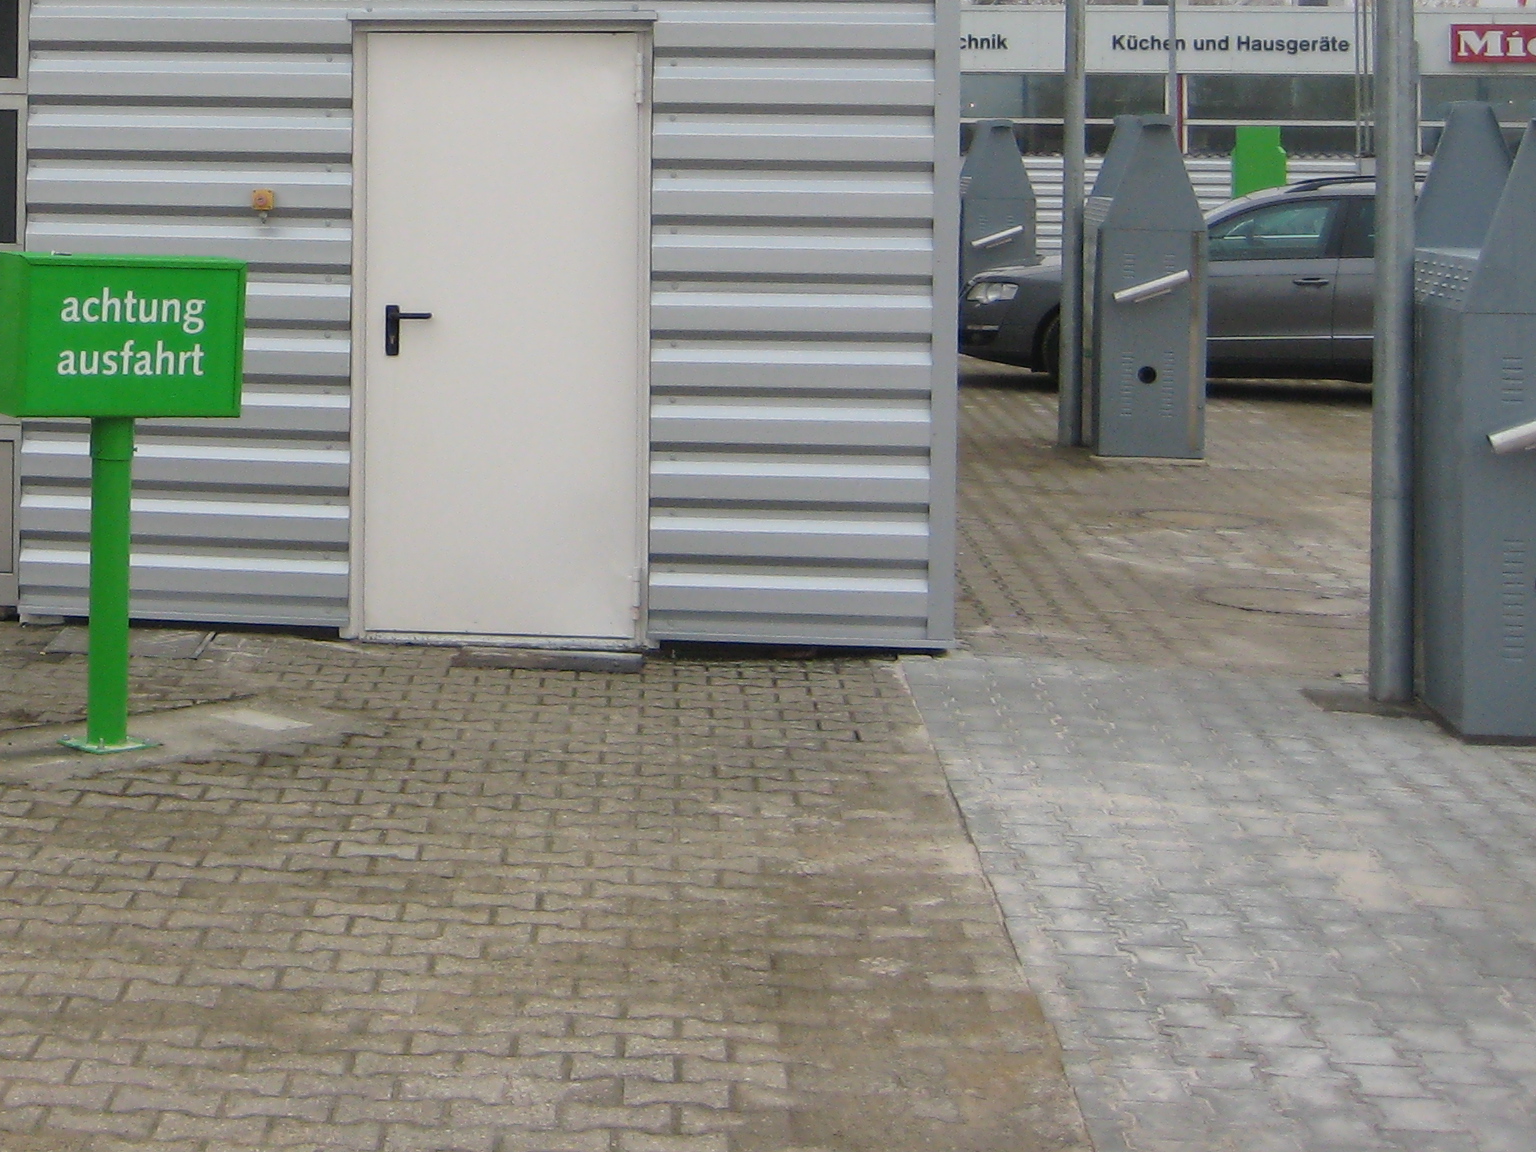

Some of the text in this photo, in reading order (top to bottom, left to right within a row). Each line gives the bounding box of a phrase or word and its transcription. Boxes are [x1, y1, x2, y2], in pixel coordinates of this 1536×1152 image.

[1111, 33, 1351, 56] Küchen und Hausgeräte
[60, 286, 206, 335] achtung
[56, 339, 205, 376] ausfahrt
